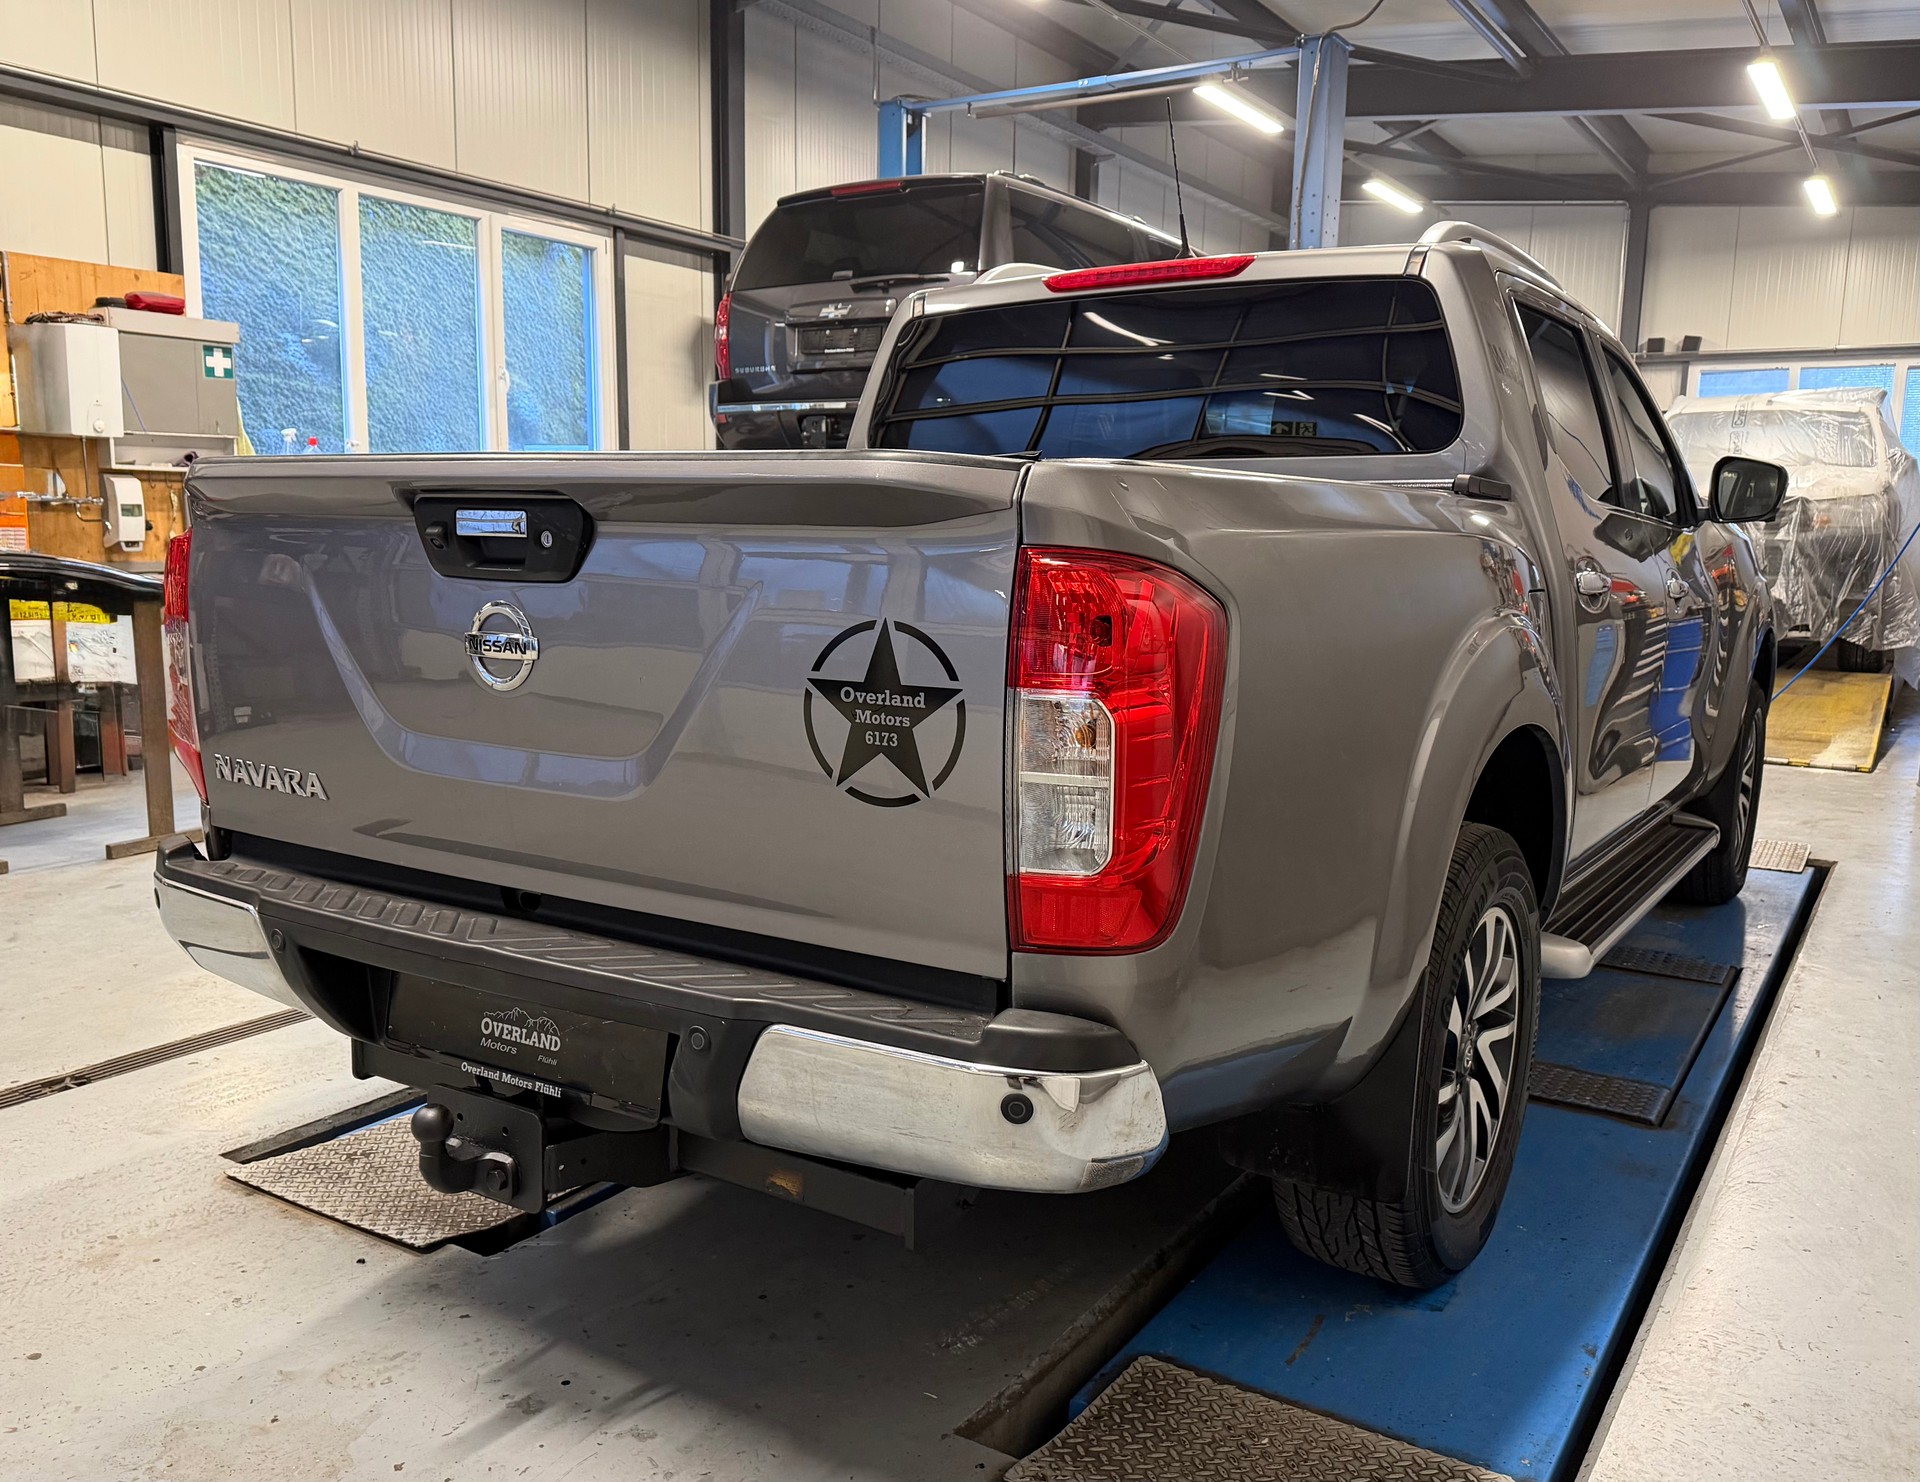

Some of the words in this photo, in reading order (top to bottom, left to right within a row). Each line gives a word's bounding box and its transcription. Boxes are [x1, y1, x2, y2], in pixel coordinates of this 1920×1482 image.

[469, 637, 527, 655] NISSAN
[840, 686, 926, 709] Overland
[855, 709, 911, 727] Motors
[865, 730, 898, 747] 6173
[214, 753, 330, 801] NAVARA
[481, 1017, 561, 1052] OVERLAND
[480, 1037, 518, 1055] Motors
[537, 1054, 558, 1066] Flühli
[461, 1061, 500, 1081] Overland
[501, 1072, 533, 1090] Motors
[534, 1081, 562, 1098] Flühli
